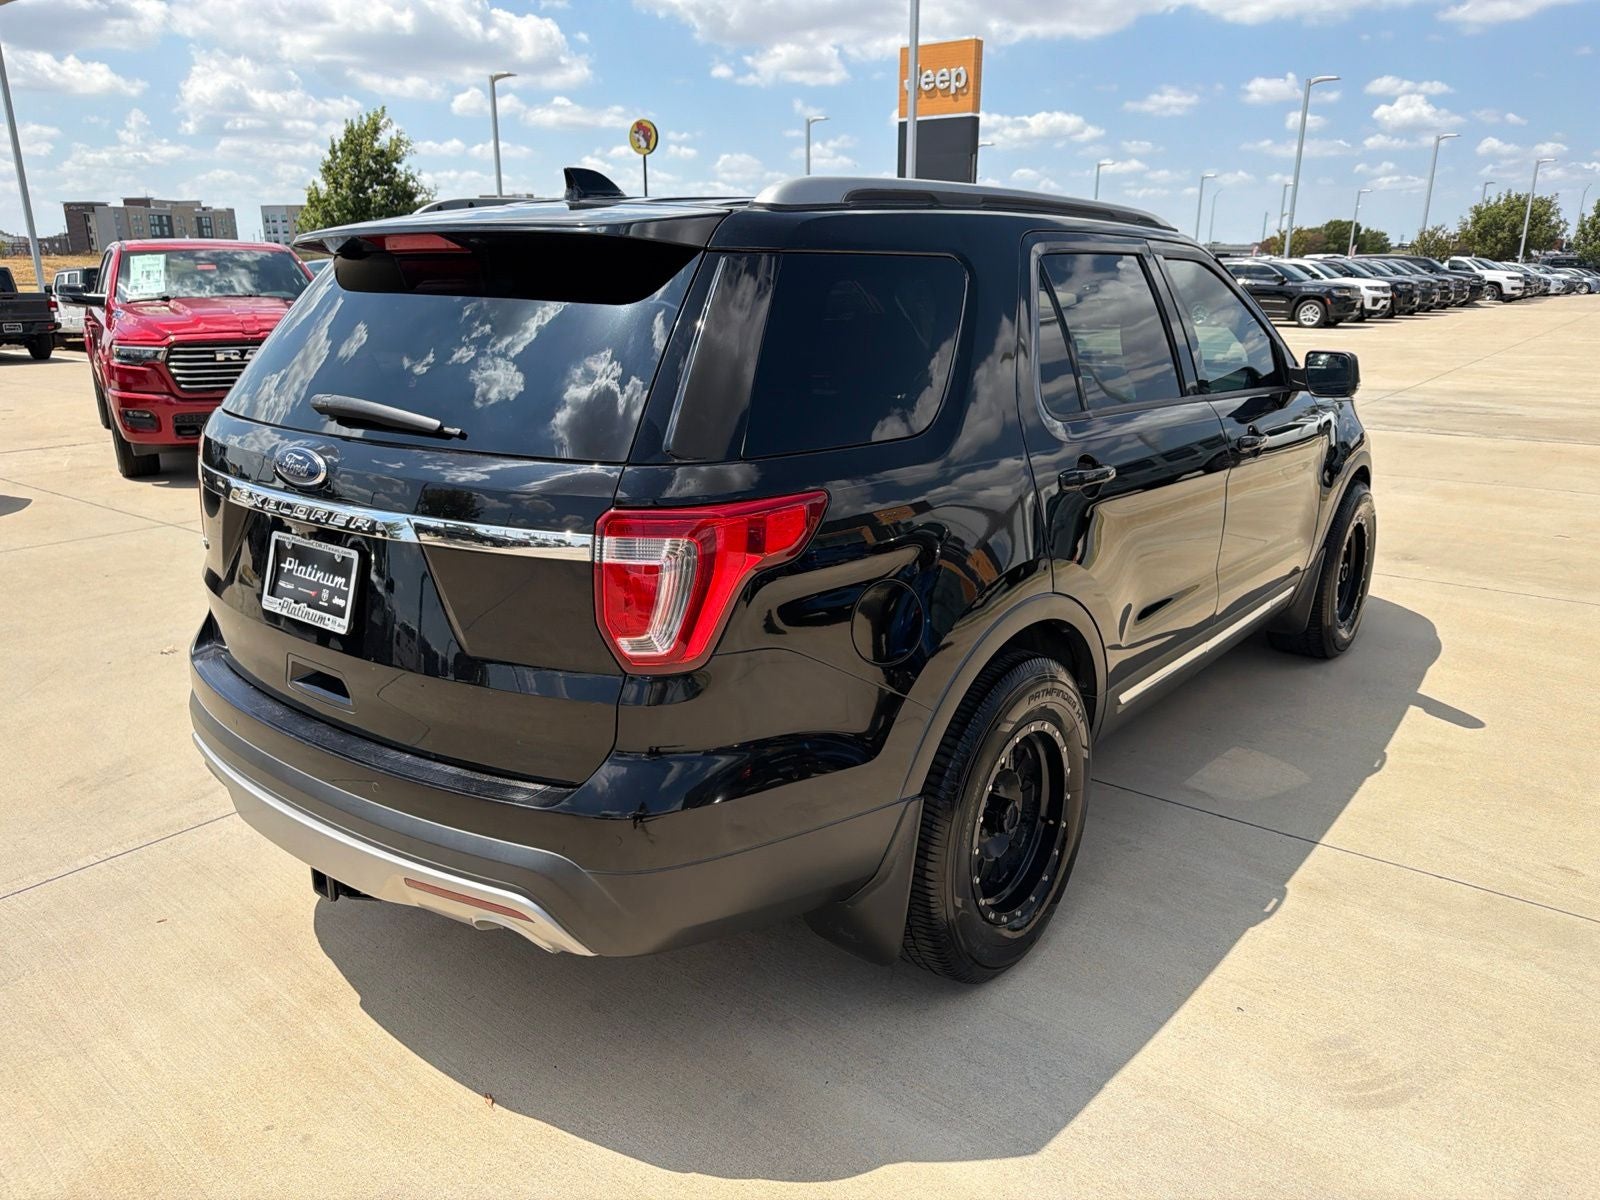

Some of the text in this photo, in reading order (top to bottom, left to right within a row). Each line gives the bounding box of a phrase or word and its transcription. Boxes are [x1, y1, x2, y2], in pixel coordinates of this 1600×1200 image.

[281, 452, 311, 478] Ford
[238, 488, 372, 532] EXPLORER
[280, 556, 349, 591] Platinum
[280, 599, 330, 627] Platinum
[1028, 687, 1077, 710] PATHFINDER
